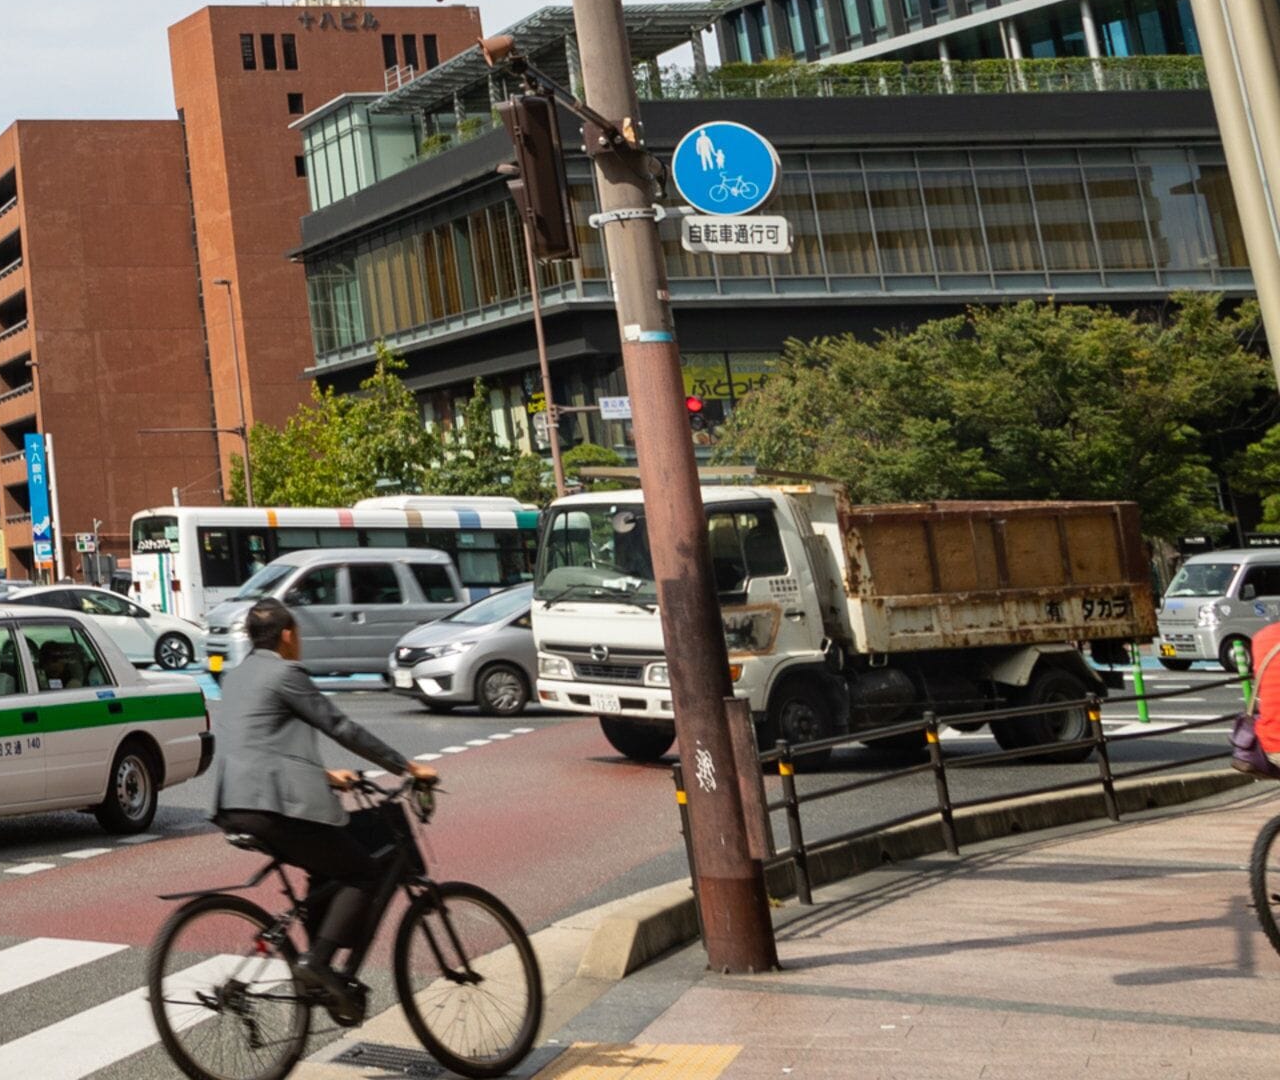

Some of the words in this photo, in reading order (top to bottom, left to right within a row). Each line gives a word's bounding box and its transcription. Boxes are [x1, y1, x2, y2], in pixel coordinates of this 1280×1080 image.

[688, 224, 780, 244] 自転車通行可
[27, 736, 41, 749] 140
